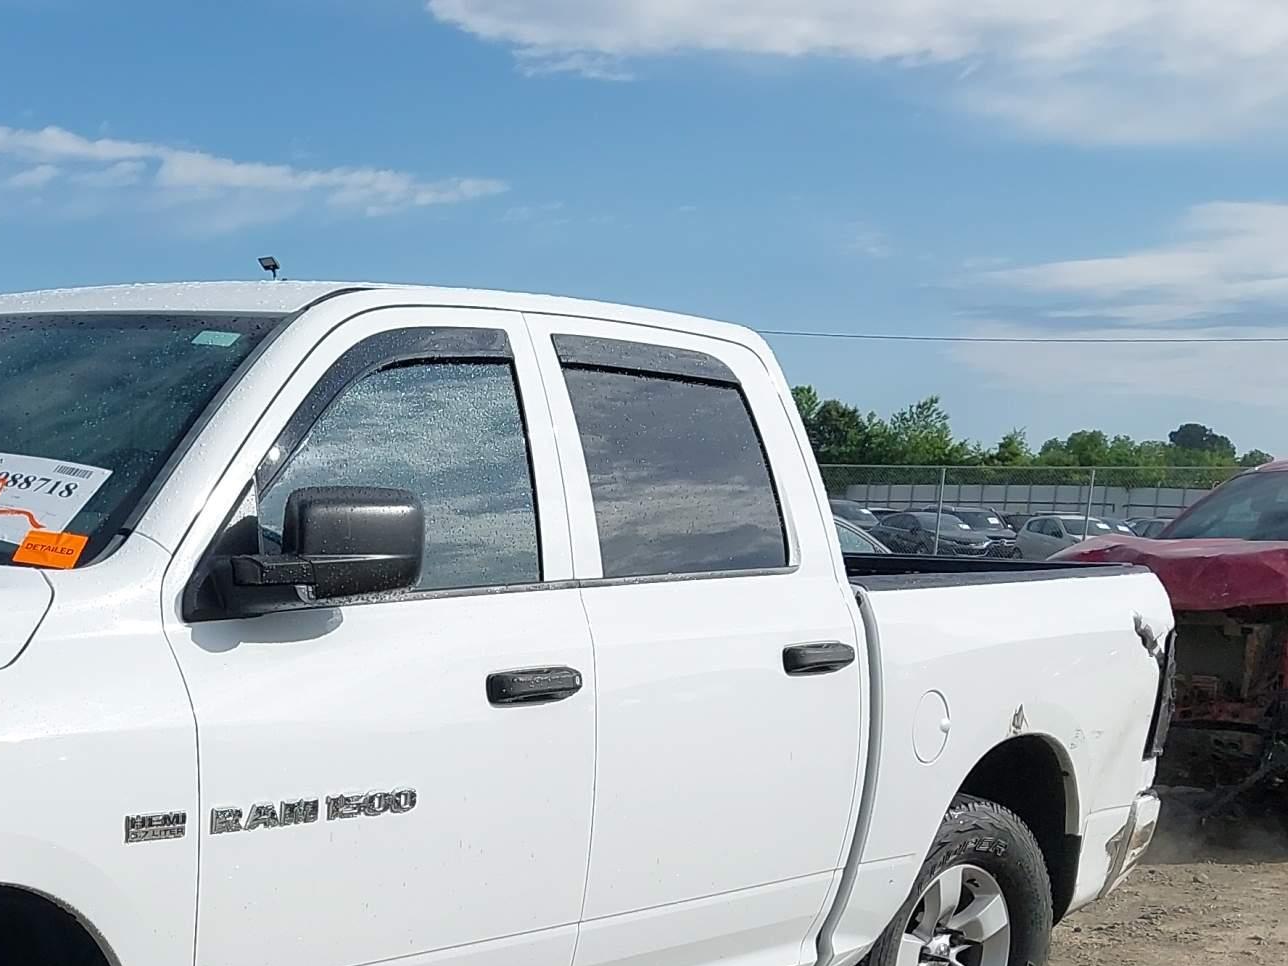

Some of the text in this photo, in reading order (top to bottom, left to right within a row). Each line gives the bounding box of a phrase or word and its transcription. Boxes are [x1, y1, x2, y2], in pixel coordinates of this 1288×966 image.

[24, 542, 75, 556] DETAILED
[210, 788, 417, 835] RAM 1500
[130, 812, 187, 829] HEMI
[152, 827, 184, 839] LITER
